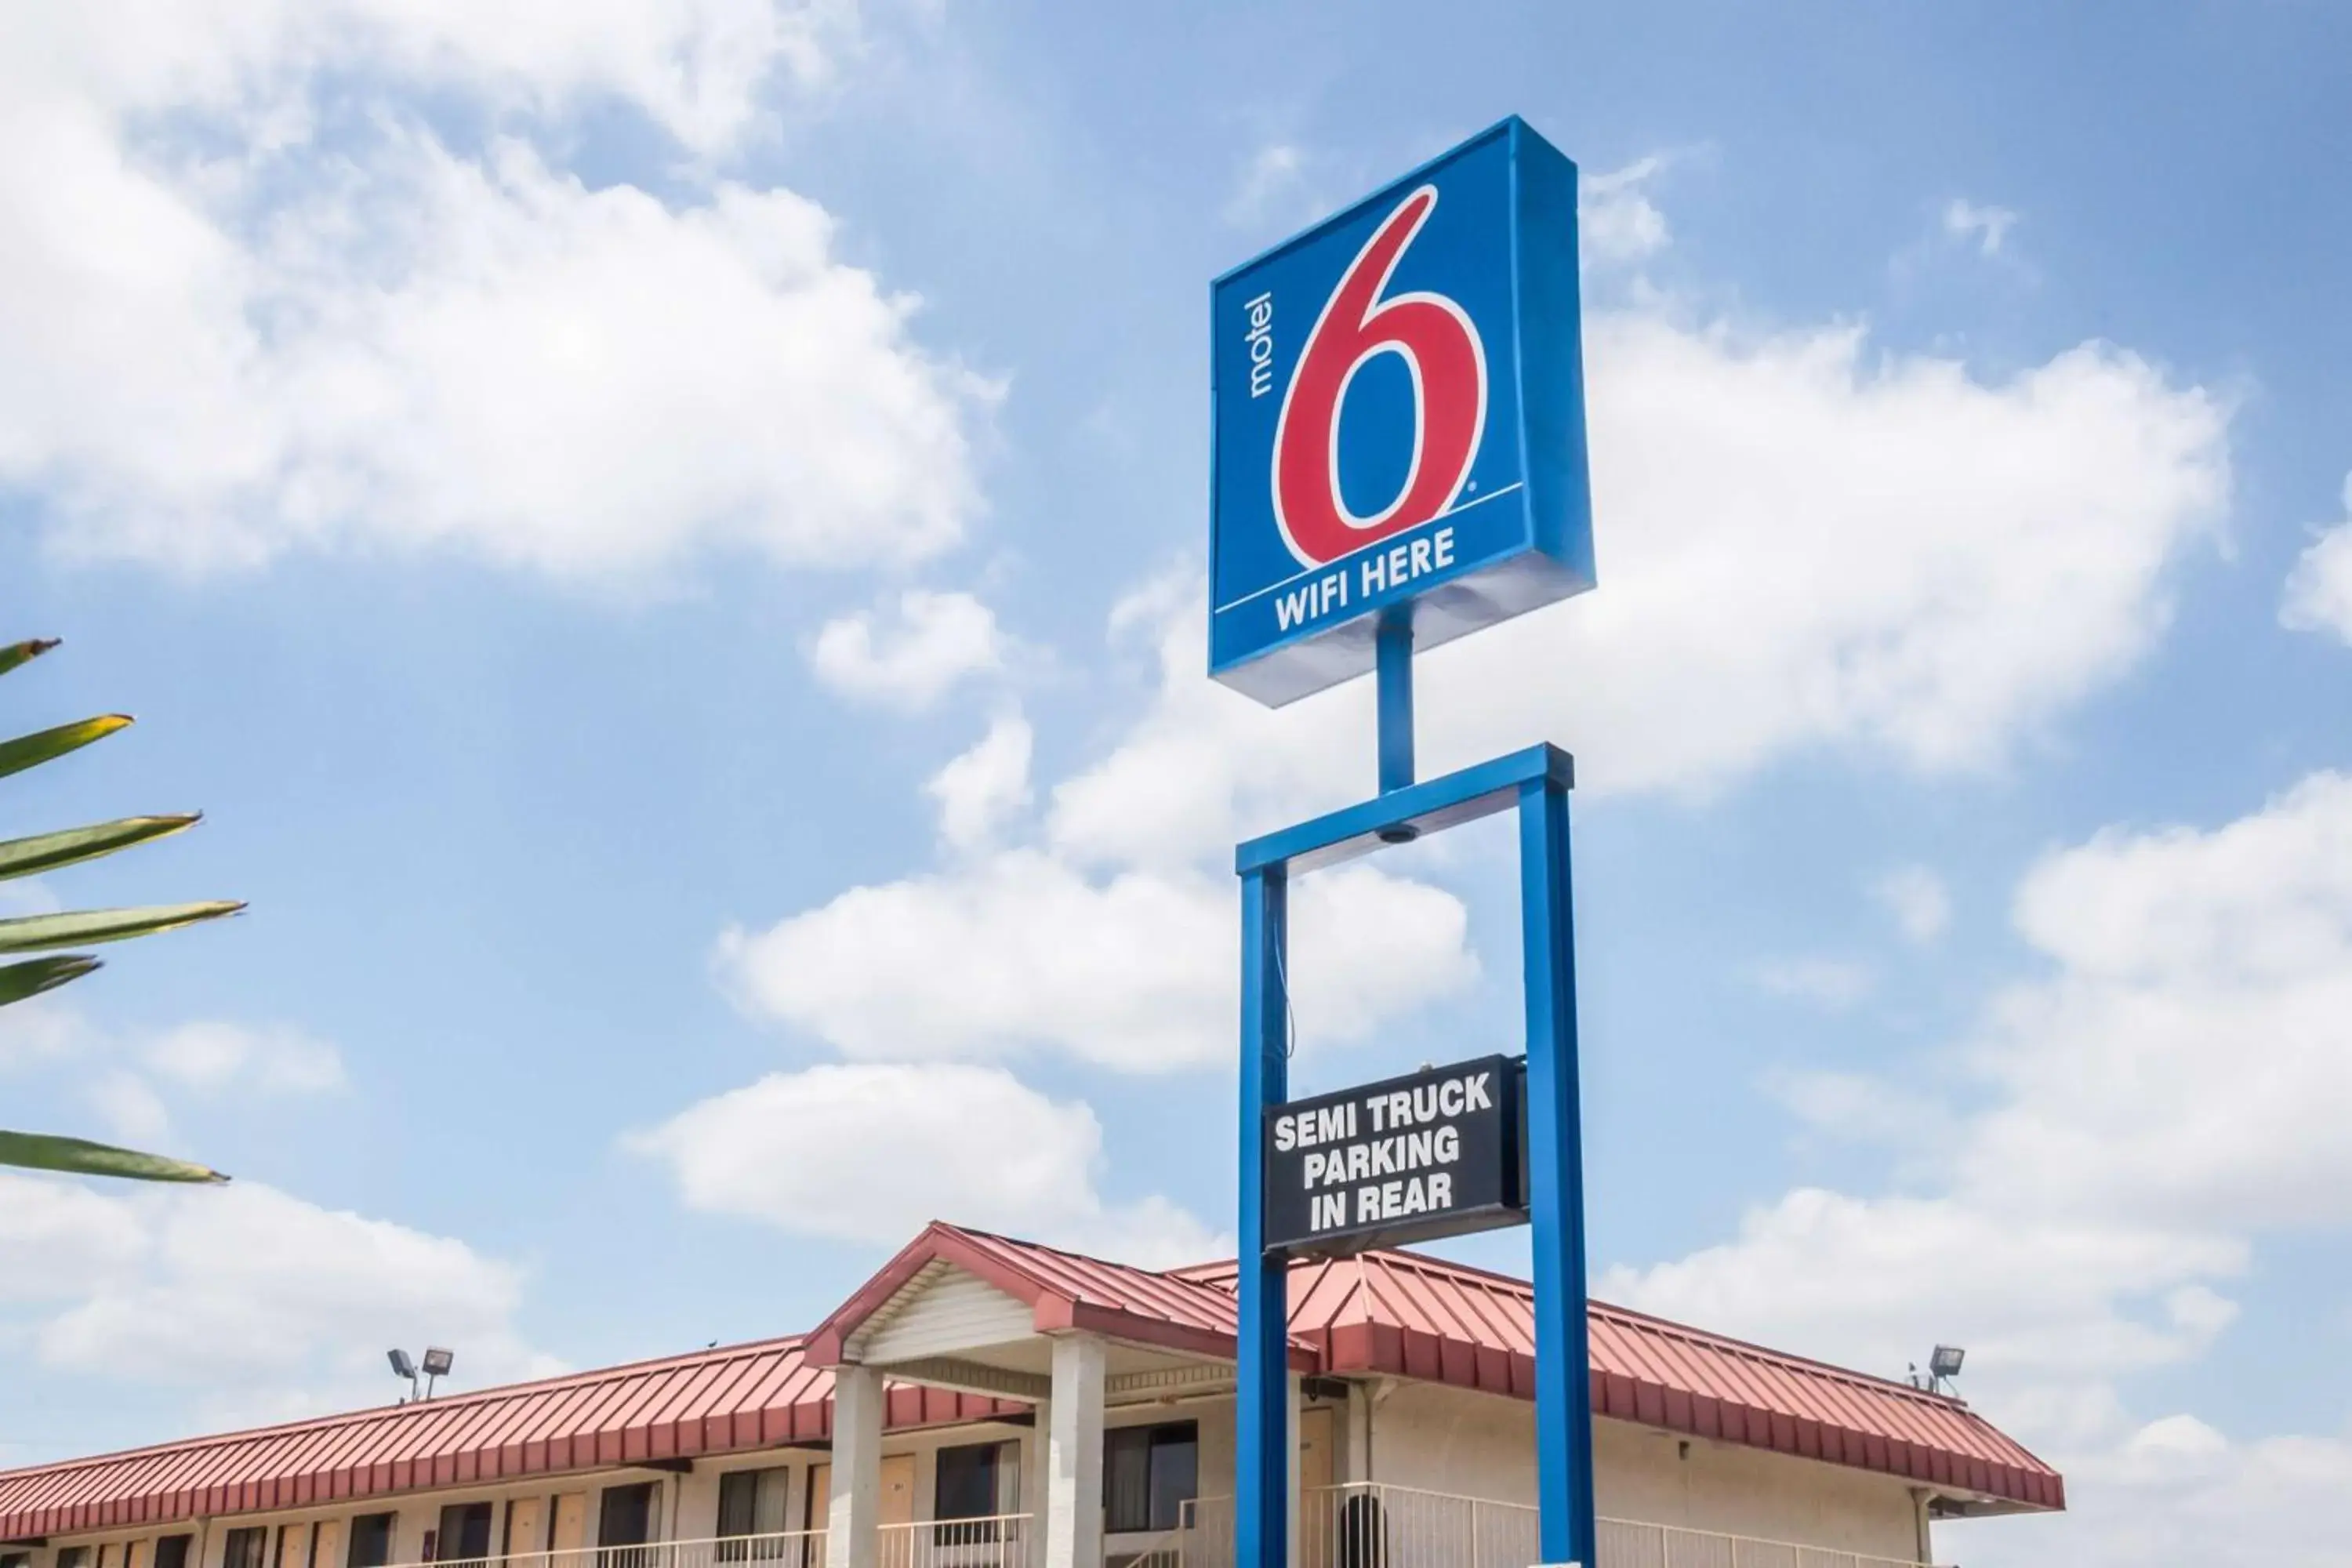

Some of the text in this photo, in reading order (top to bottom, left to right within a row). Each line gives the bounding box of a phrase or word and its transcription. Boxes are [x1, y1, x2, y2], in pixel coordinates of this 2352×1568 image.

[1244, 292, 1272, 398] motel
[1271, 184, 1488, 572] 6
[1276, 527, 1454, 631] WIFI HERE
[1275, 1072, 1493, 1152] SEMI TRUCK
[1304, 1125, 1460, 1190] PARKING
[1310, 1172, 1452, 1232] IN REAR
